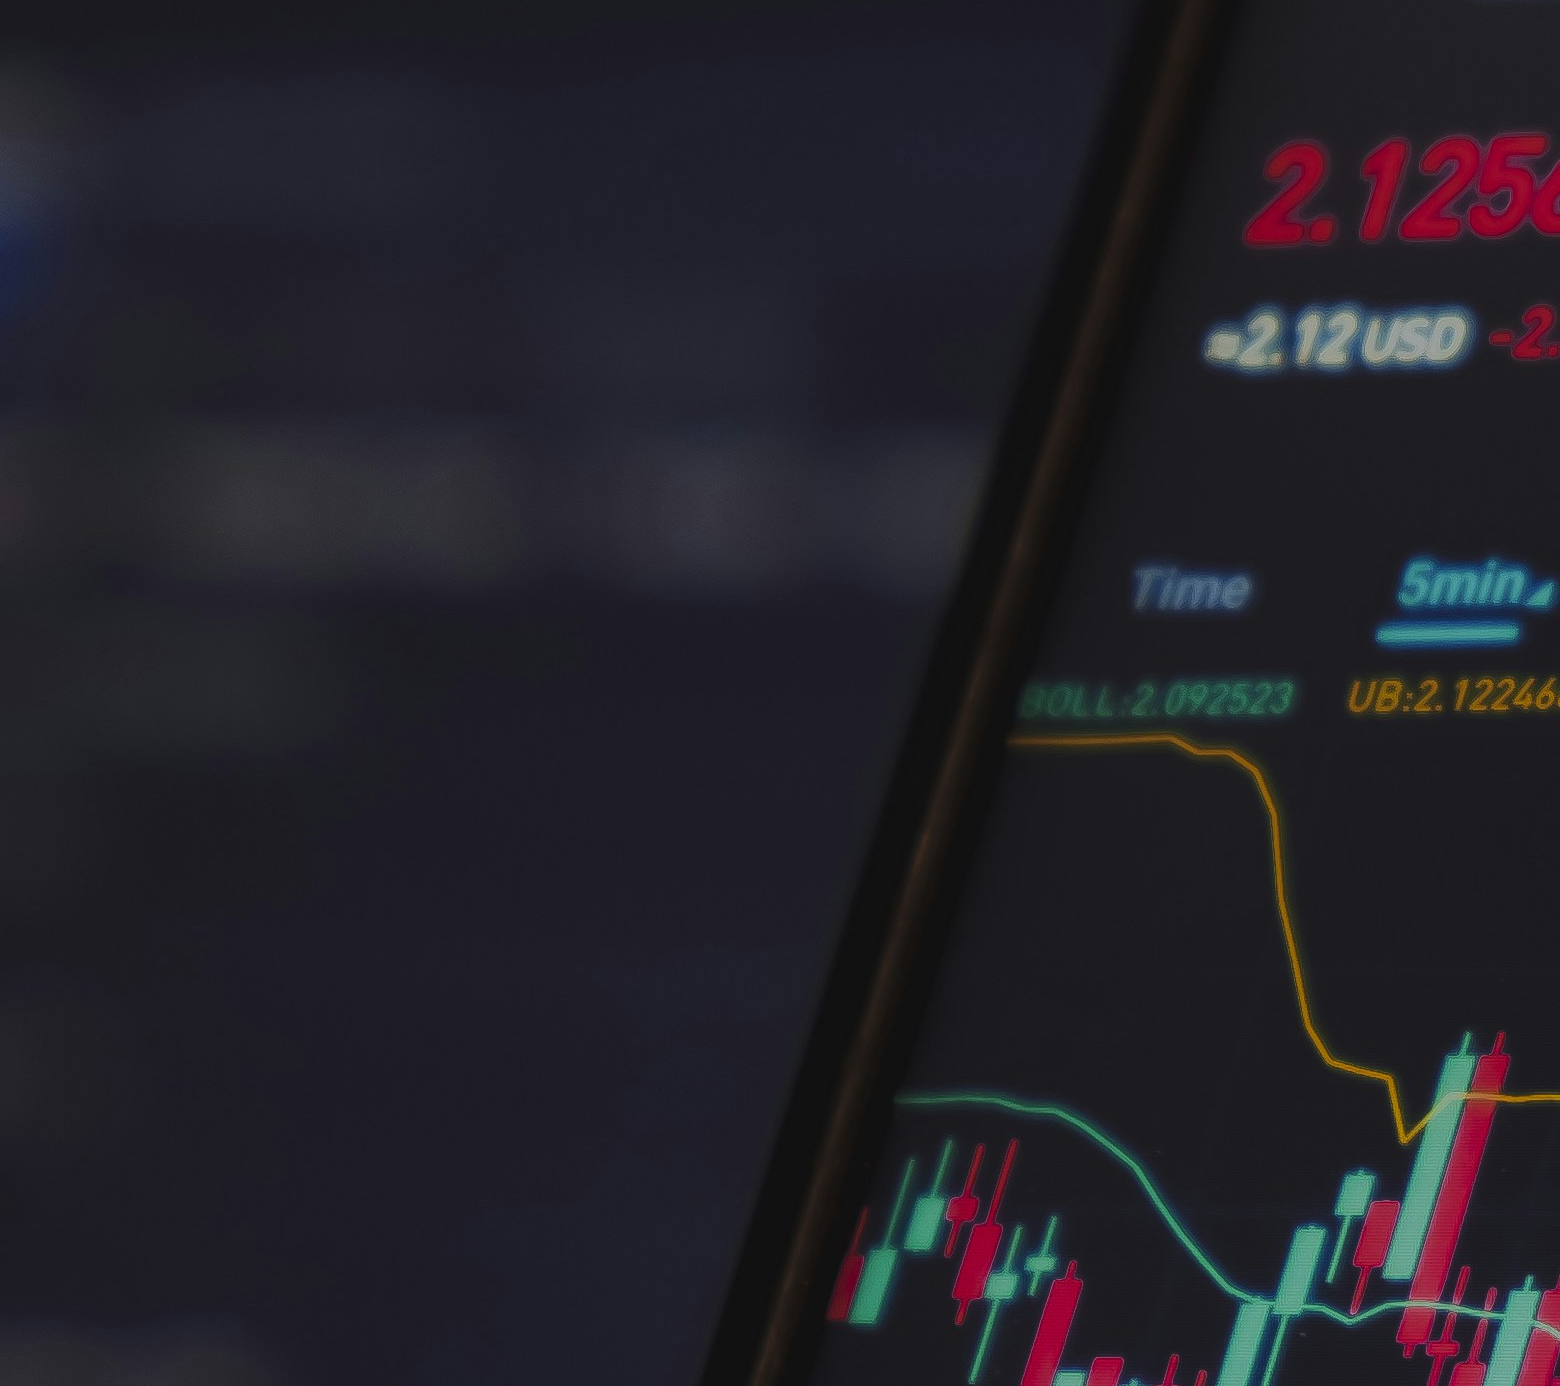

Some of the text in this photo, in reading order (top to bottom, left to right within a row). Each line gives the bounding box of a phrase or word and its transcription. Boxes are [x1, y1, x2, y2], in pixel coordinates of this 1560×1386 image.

[1362, 312, 1467, 364] USD
[1134, 563, 1254, 612] Time
[1397, 556, 1528, 611] 5min
